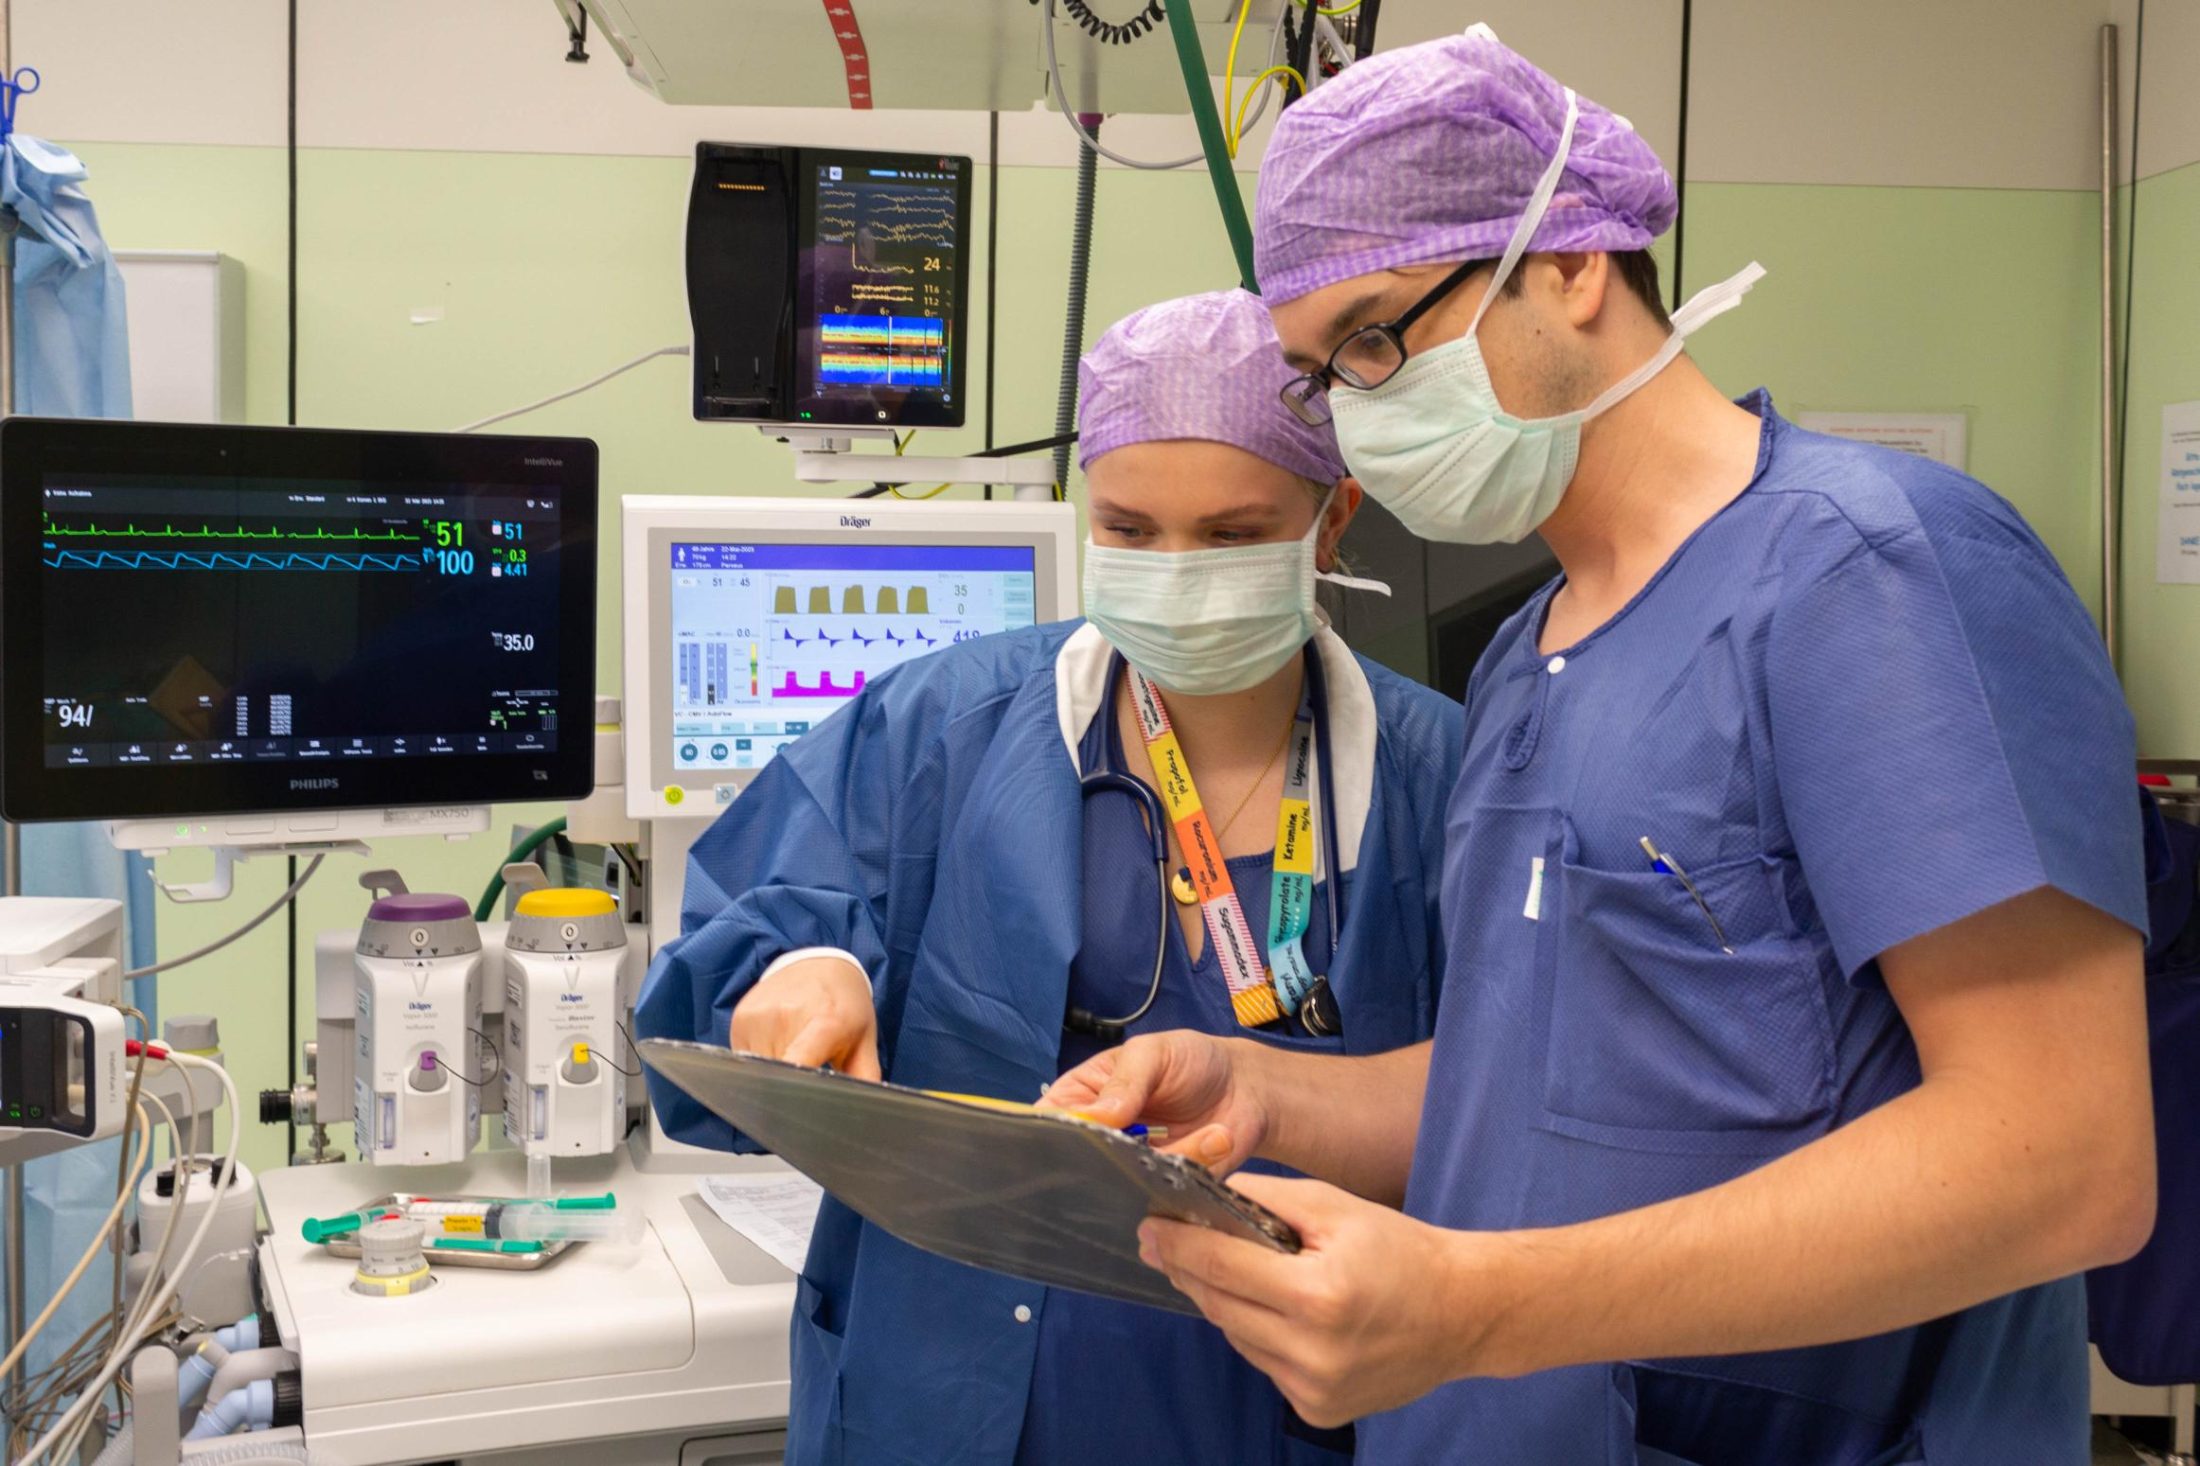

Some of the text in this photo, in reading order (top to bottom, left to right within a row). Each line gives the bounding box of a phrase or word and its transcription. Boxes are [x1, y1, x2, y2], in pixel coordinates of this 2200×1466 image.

[924, 257, 941, 271] 24
[840, 516, 871, 528] Dräger
[437, 522, 463, 546] 51
[505, 523, 523, 540] 51
[438, 550, 474, 575] 100
[509, 549, 527, 562] 0.3
[504, 563, 527, 577] 4.41
[712, 578, 722, 586] 51
[954, 585, 968, 597] 35
[958, 603, 965, 615] 0
[503, 634, 534, 651] 35.0
[59, 704, 93, 727] 94/
[1167, 749, 1188, 795] Propofol
[290, 778, 339, 790] PHILIPS
[1283, 814, 1298, 860] Ketamine
[1193, 821, 1218, 882] Rocuronium
[1219, 907, 1250, 980] Sugammadex
[561, 994, 583, 1002] Dräger
[409, 1002, 432, 1011] Dräger
